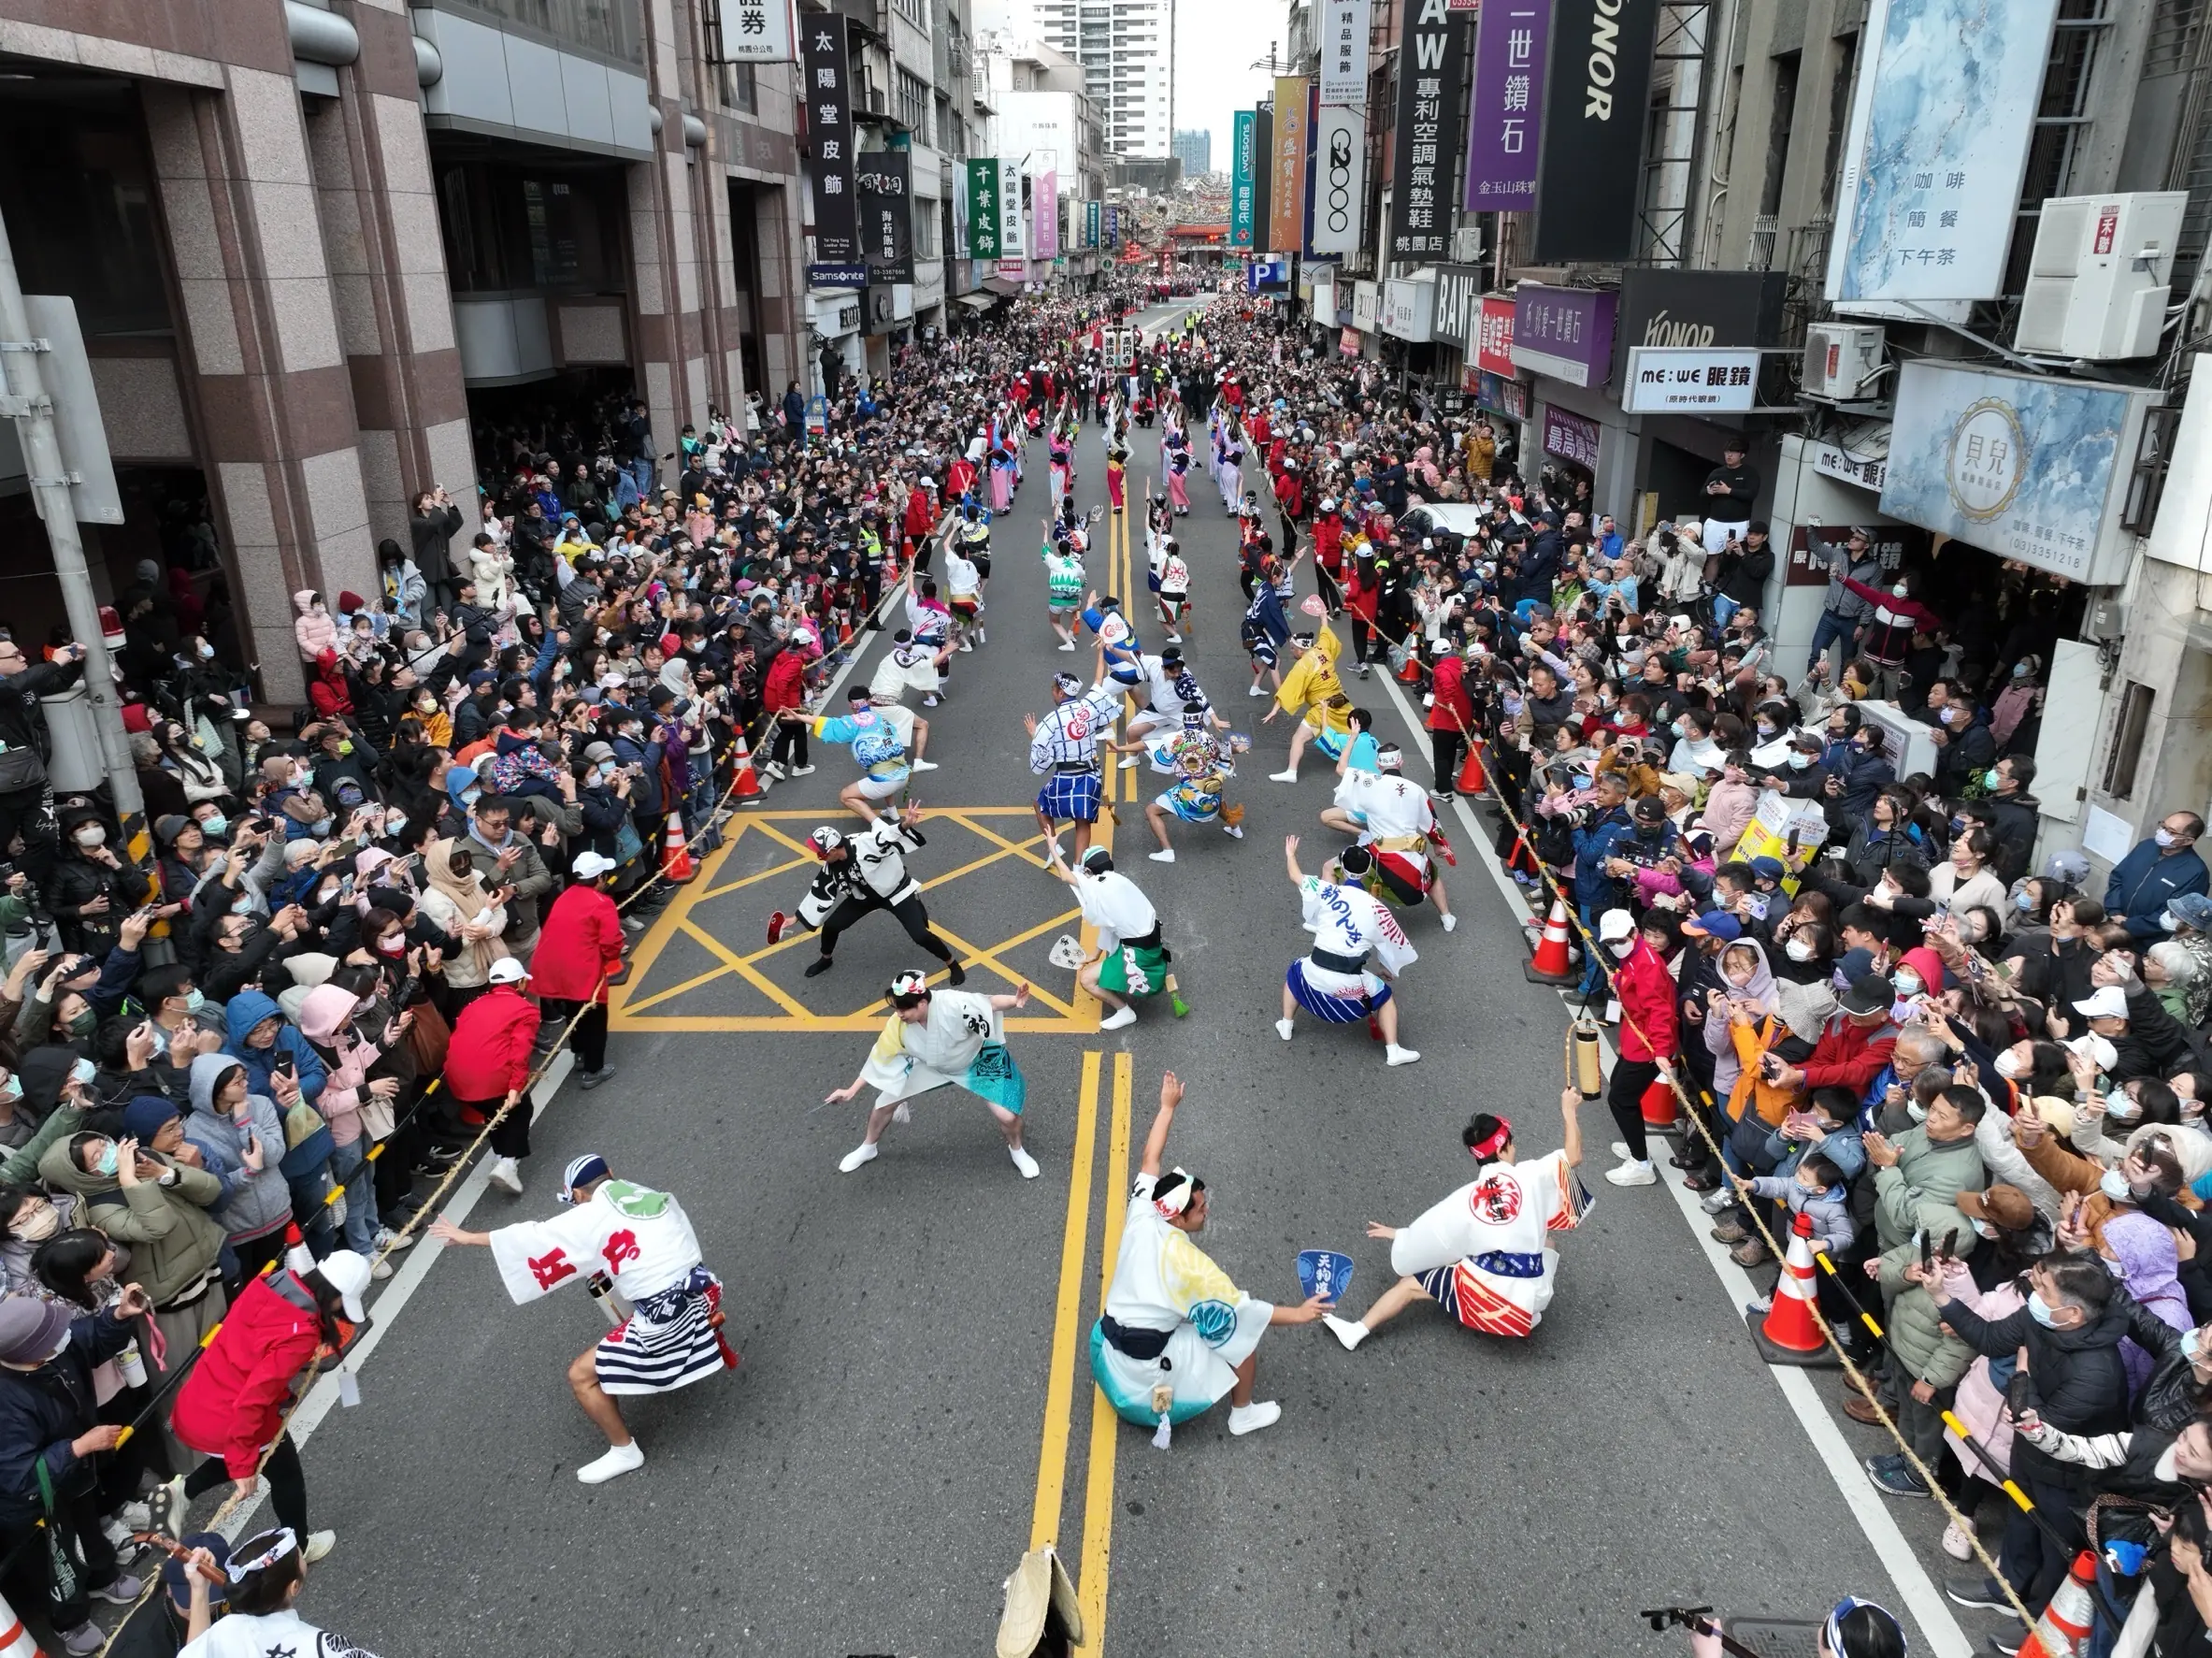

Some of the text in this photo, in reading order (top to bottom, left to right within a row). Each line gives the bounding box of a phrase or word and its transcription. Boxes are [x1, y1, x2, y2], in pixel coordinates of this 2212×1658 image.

[738, 44, 773, 53] 桃園分公司
[1340, 11, 1354, 74] 精品服飾
[1501, 11, 1535, 153] 一世鑽石
[815, 31, 842, 195] 太陽堂皮飾
[1242, 123, 1250, 173] watsons
[1408, 78, 1441, 228] 專利空調氣墊鞋
[1328, 128, 1351, 233] G2000
[1913, 172, 1965, 190] 咖啡
[1005, 165, 1017, 243] 太陽堂皮飾
[1239, 186, 1250, 224] 屈臣氏
[1907, 210, 1958, 228] 簡餐
[1396, 236, 1443, 252] 桃園店
[1898, 248, 1956, 266] 下午茶
[812, 271, 865, 281] Samsonite
[1255, 265, 1271, 285] P
[1706, 366, 1751, 386] 眼鏡
[1964, 434, 2007, 475] 貝兒
[1320, 884, 1363, 948] 新のんき
